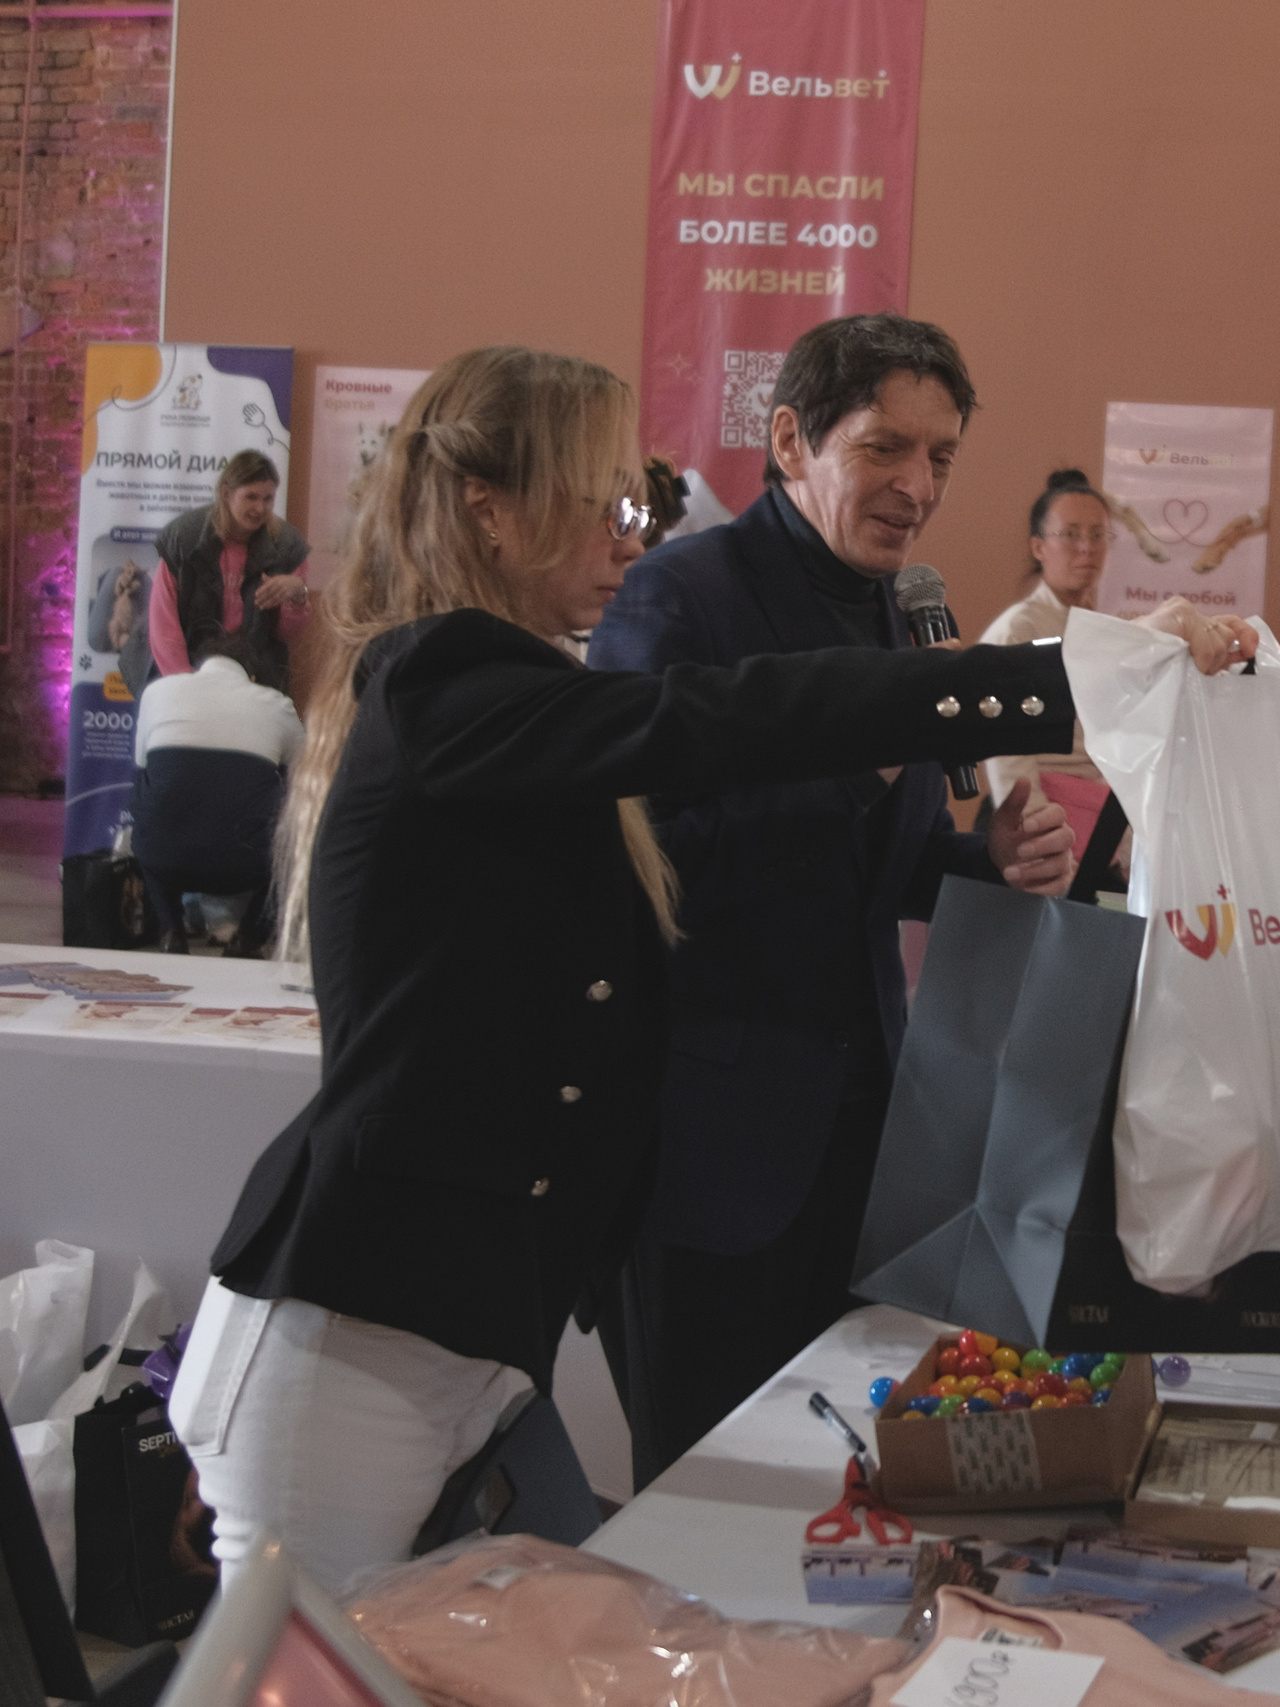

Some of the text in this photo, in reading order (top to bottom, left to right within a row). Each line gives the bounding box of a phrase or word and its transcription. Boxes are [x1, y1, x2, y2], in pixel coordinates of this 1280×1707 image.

[748, 70, 890, 99] Вельвет
[678, 173, 884, 201] МЫ СПАСЛИ
[679, 219, 878, 249] БОЛЕЕ 4000
[704, 266, 846, 296] ЖИЗНЕЙ
[325, 379, 392, 394] Кровные
[96, 449, 181, 470] ПРЯМОЙ
[1125, 586, 1157, 602] Мы
[83, 710, 133, 731] 2000
